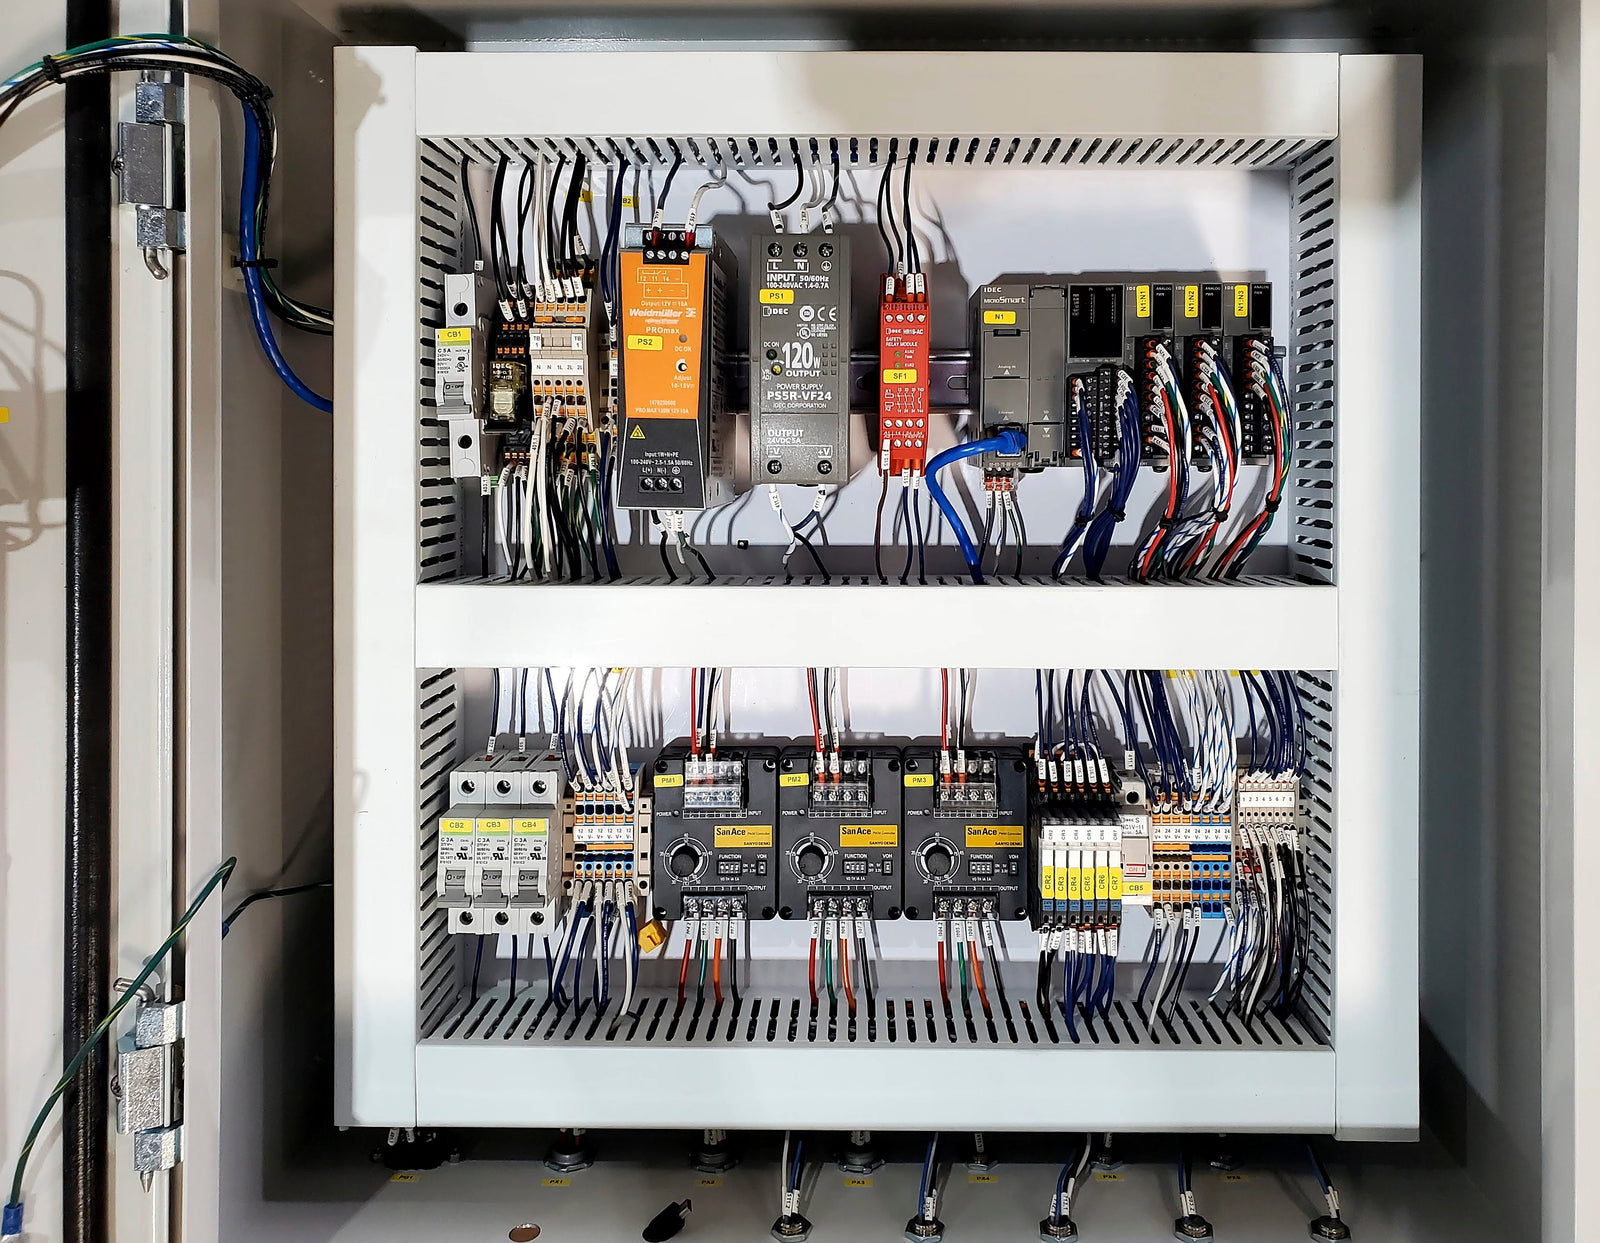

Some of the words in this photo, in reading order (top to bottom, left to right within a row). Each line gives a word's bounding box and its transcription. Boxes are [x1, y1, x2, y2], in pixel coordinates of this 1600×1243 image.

[767, 274, 796, 282] INPUT
[630, 308, 683, 317] Weidmüller
[767, 392, 832, 401] PS5R-VF24
[768, 429, 804, 437] OUTPUT
